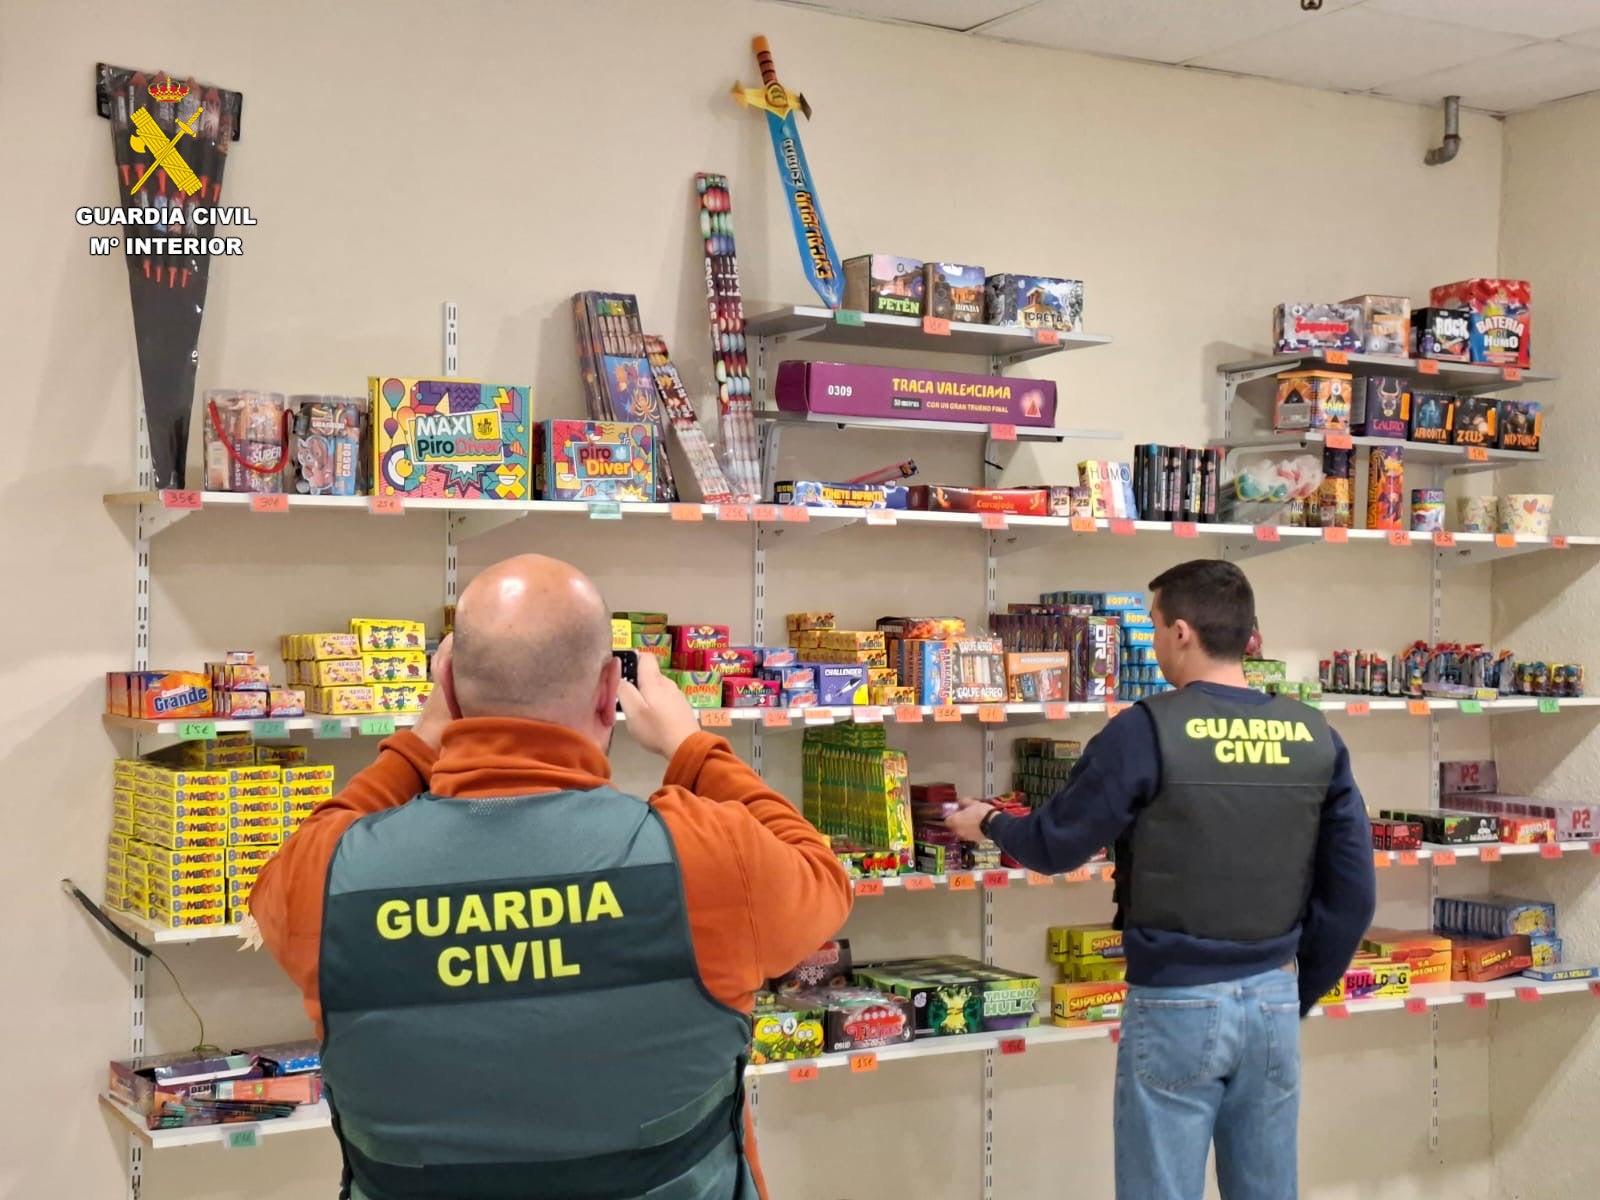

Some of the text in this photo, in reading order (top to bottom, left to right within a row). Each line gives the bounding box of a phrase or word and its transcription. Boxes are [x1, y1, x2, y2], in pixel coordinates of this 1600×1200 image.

[1435, 318, 1468, 338] ROCK
[828, 385, 852, 397] 0309
[892, 378, 1011, 399] TRACA VALENCIANA
[966, 404, 991, 412] TRUENO
[991, 405, 1008, 413] FINAL
[417, 415, 471, 436] MAXI
[1457, 430, 1484, 443] ZEUS
[579, 446, 611, 464] piro
[586, 459, 632, 476] Diver
[1090, 467, 1130, 481] HUMO
[170, 493, 197, 504] 35€
[1054, 497, 1068, 506] 25
[1077, 498, 1090, 507] 25
[1106, 625, 1115, 674] SUPER
[154, 686, 208, 713] Grande
[1186, 718, 1314, 742] GUARDIA
[1215, 740, 1290, 764] CIVIL
[376, 881, 624, 940] GUARDIA
[437, 938, 581, 987] CIVIL
[984, 988, 1035, 1001] TRUENO
[984, 1000, 1035, 1016] HULK
